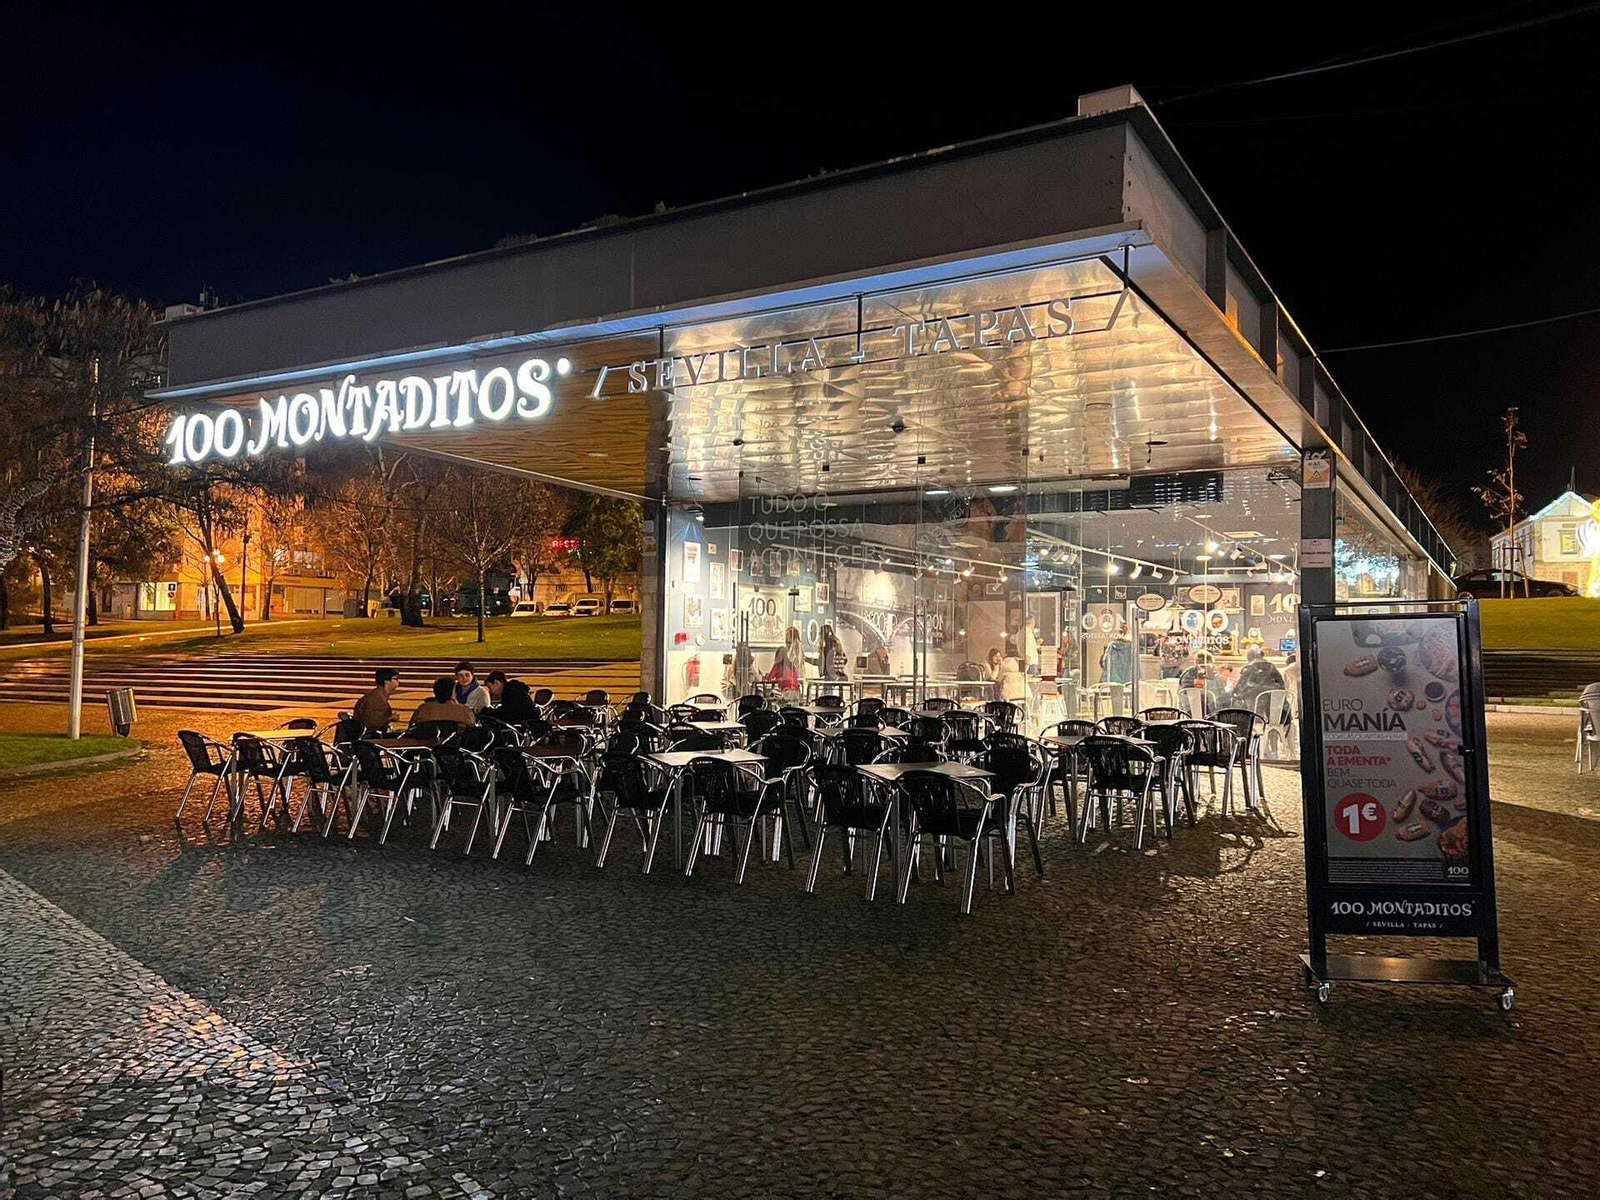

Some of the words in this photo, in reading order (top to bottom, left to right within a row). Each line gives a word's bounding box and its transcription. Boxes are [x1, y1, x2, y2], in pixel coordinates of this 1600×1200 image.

[628, 337, 827, 394] SEVILLA
[893, 298, 1076, 357] TAPAS
[166, 408, 244, 465] 100
[248, 358, 552, 455] MONTADITOS
[748, 493, 807, 515] TUDO
[748, 521, 791, 544] QUE
[748, 597, 776, 616] 100
[1322, 698, 1363, 711] EURO
[1323, 708, 1407, 731] MANÍA
[1326, 745, 1360, 755] TODA
[1326, 756, 1335, 766] A
[1327, 778, 1363, 789] QUASE
[1366, 778, 1397, 789] TODA
[1343, 802, 1378, 834] 1€
[1447, 866, 1469, 875] 100
[1331, 901, 1365, 915] 100
[1367, 900, 1472, 917] MONTADITOS
